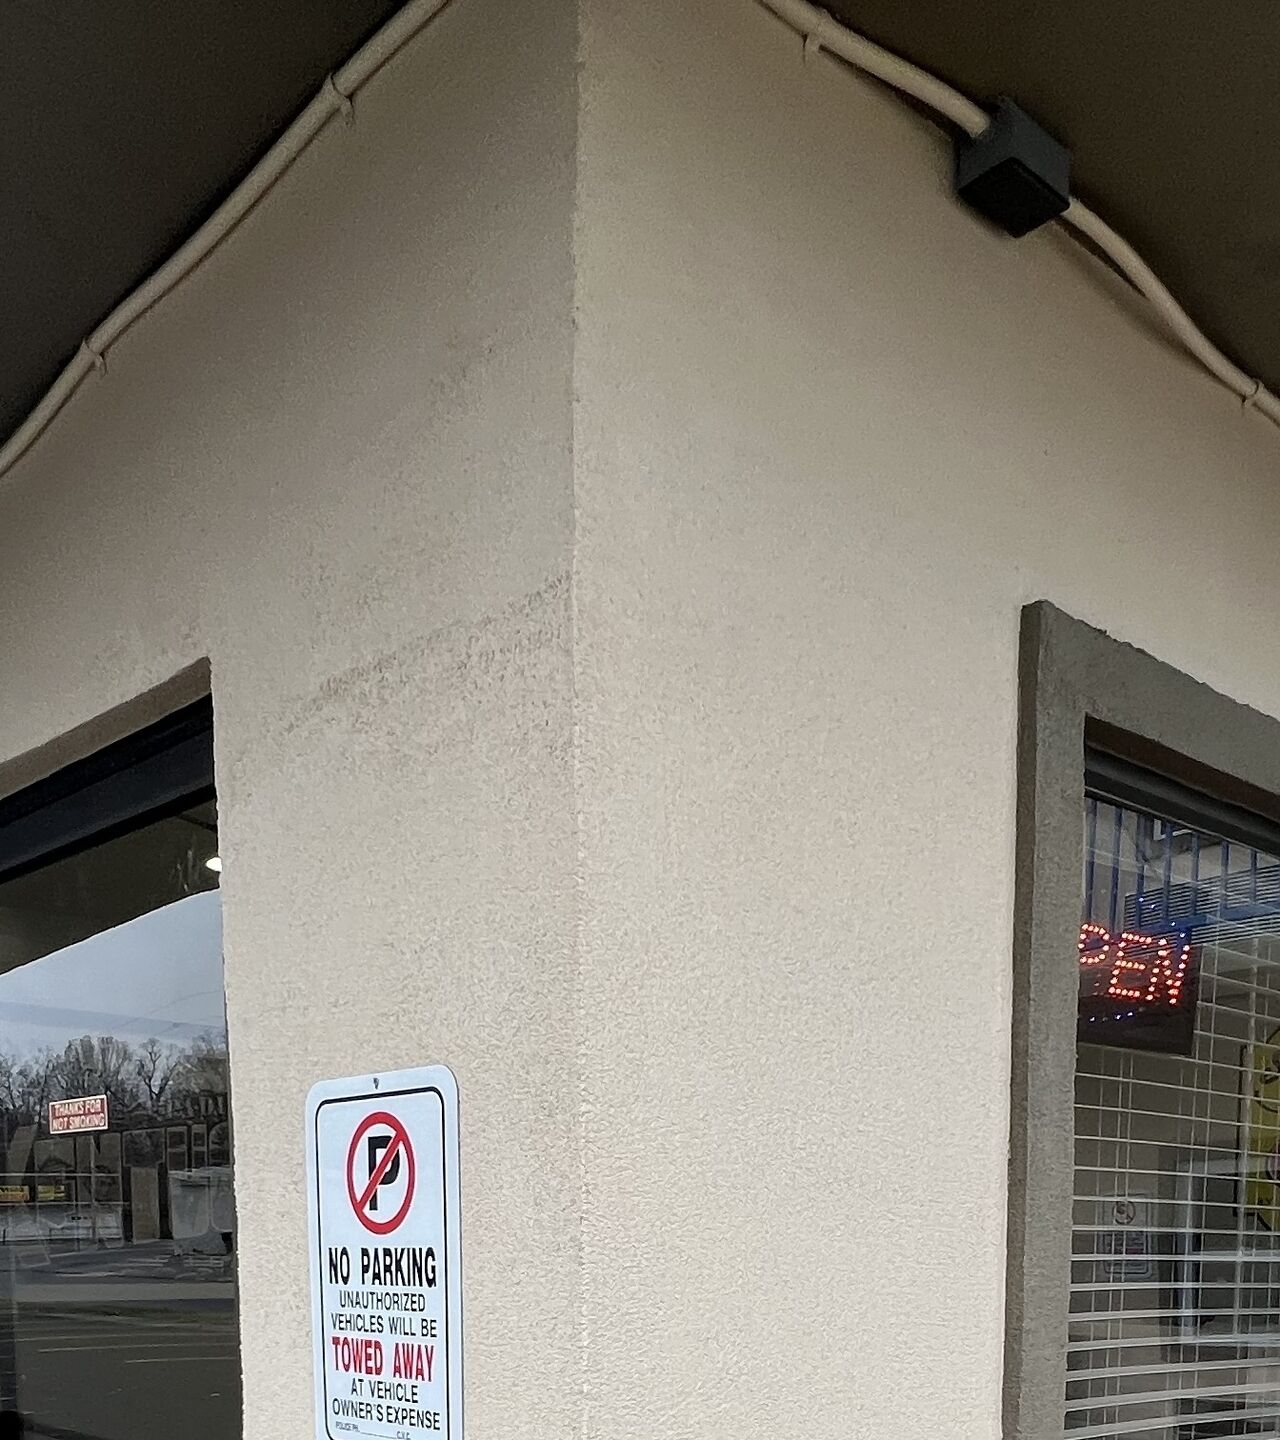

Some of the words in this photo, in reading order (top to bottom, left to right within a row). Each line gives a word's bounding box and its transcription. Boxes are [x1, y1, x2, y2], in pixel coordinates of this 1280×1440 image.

[1078, 923, 1190, 1005] PEN
[55, 1101, 84, 1117] THANKS
[85, 1099, 101, 1113] FOR
[53, 1117, 68, 1130] NOT
[69, 1113, 104, 1129] SMOKING
[328, 1246, 350, 1285] NO
[360, 1247, 437, 1288] PARKING
[339, 1290, 426, 1312] UNAUTHORIZED
[331, 1313, 384, 1333] VEHICLES
[388, 1317, 417, 1336] WILL
[421, 1318, 438, 1337] BE
[332, 1337, 384, 1376] TOWED
[393, 1343, 435, 1382] AWAY
[351, 1378, 365, 1396] AT
[368, 1380, 419, 1403] VEHICLE
[332, 1397, 384, 1422] OWNER'S
[386, 1406, 441, 1430] EXPENSE
